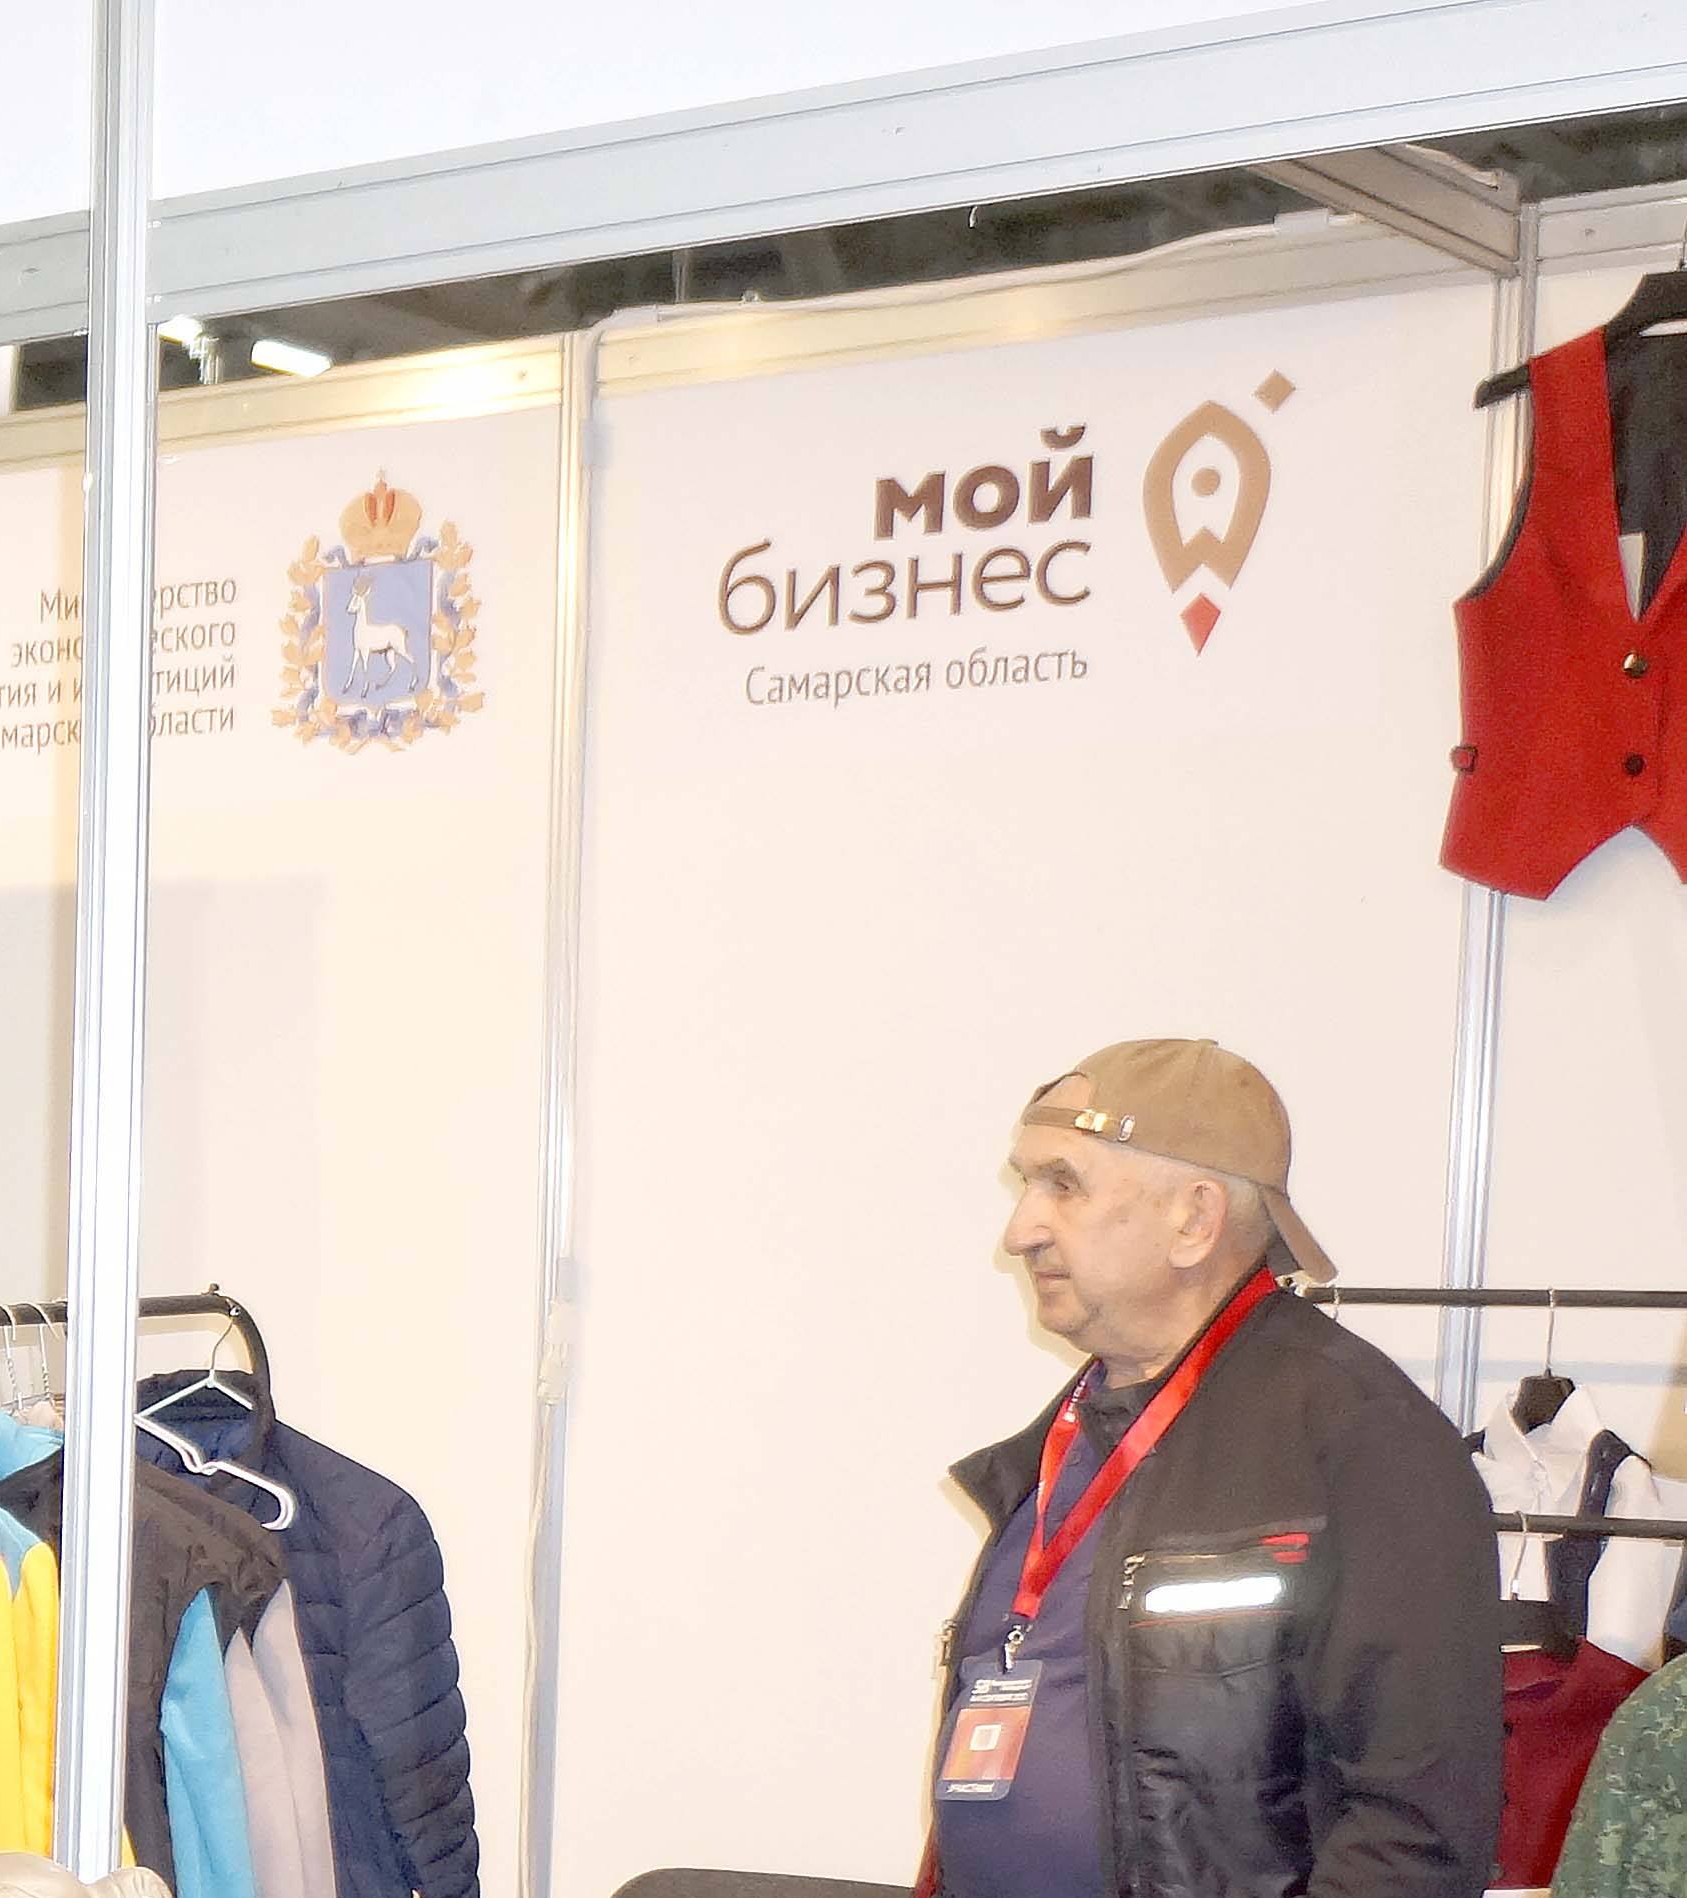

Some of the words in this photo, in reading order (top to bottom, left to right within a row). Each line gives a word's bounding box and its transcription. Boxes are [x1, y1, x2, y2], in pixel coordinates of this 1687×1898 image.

[874, 424, 1094, 540] мой
[40, 578, 237, 624] Мирство
[717, 538, 1092, 635] бизнес
[47, 679, 62, 704] и
[745, 660, 931, 708] Самарская
[945, 646, 1088, 690] область
